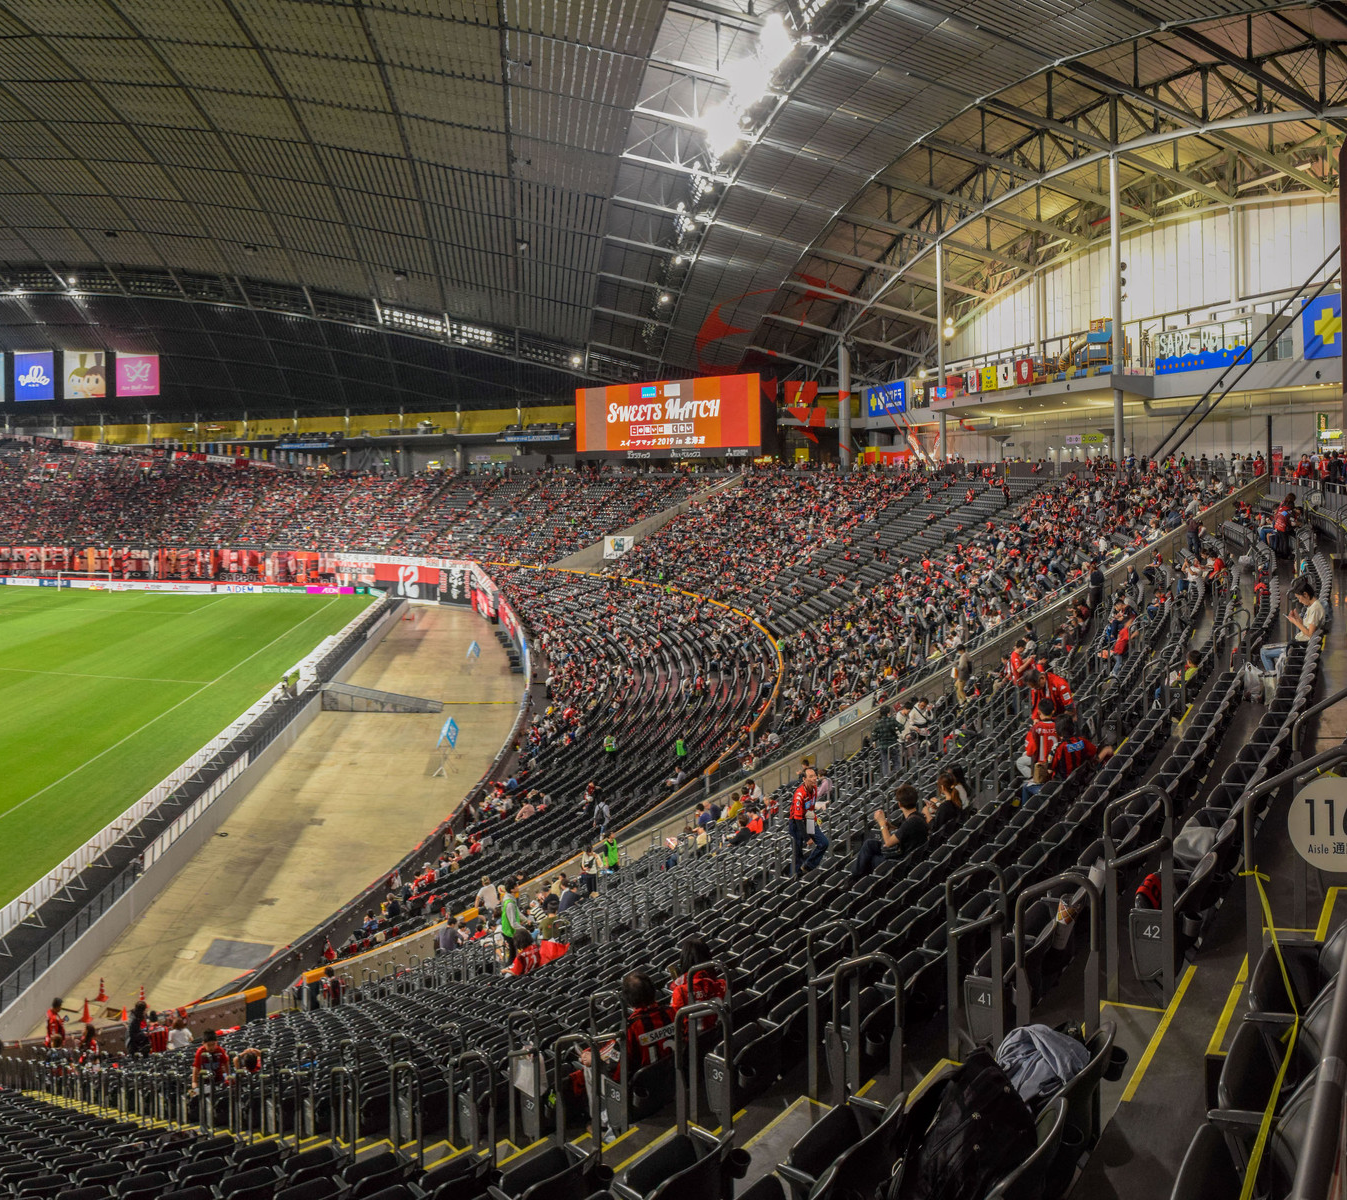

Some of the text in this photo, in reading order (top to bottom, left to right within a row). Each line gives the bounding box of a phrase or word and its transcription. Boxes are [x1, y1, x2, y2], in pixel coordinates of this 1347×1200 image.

[607, 398, 721, 424] SWEETS MATCH
[657, 436, 674, 446] 2019
[676, 437, 683, 445] in
[685, 436, 705, 445] 北海道
[397, 565, 420, 598] 12
[226, 585, 254, 593] AIDEM
[1305, 799, 1347, 836] 11
[1307, 842, 1347, 855] Aisle 通
[1142, 925, 1161, 939] 42
[978, 992, 992, 1006] 41
[712, 1068, 724, 1082] 39
[610, 1090, 621, 1101] 38
[525, 1101, 535, 1111] 37
